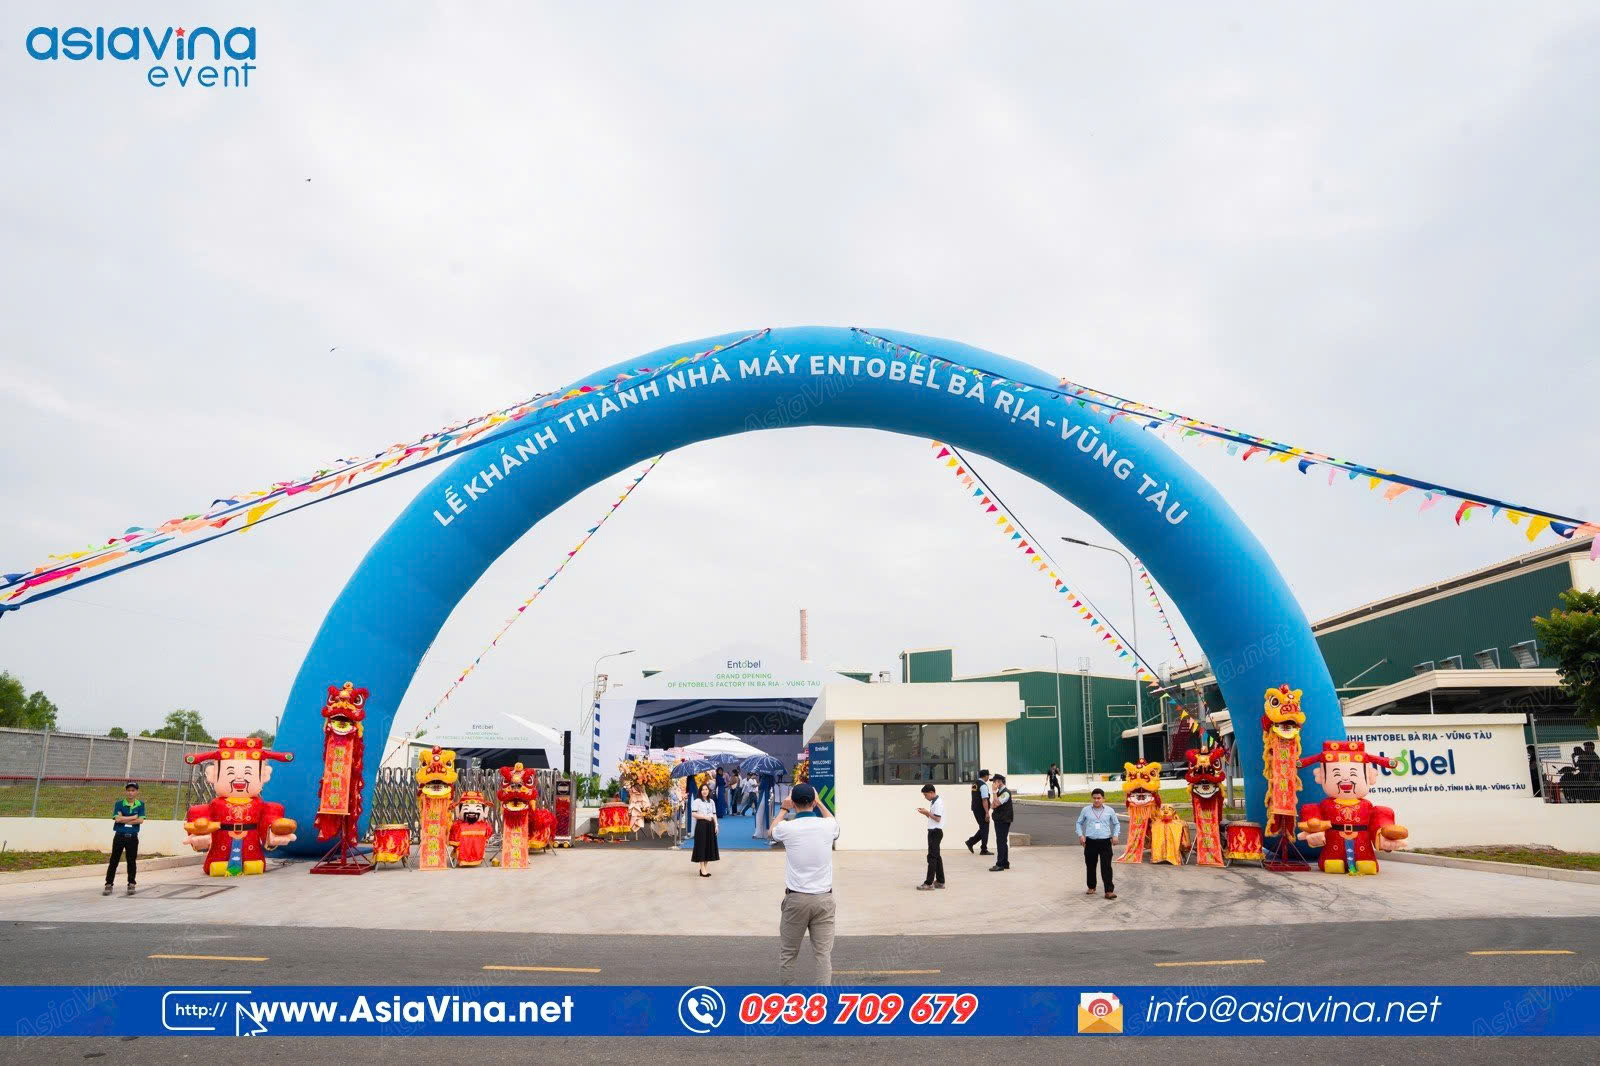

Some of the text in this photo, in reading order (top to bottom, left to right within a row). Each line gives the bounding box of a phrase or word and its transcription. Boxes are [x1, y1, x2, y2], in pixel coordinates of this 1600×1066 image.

[433, 485, 467, 526] LỄ
[463, 425, 558, 501] KHÁNH
[558, 380, 660, 434] THÀNH
[666, 358, 731, 392] NHÀ
[738, 350, 801, 380] MÁY
[810, 354, 941, 390] ENTOBEL
[1136, 473, 1189, 526] TÀU
[1366, 733, 1406, 742] ENTOBEL
[1408, 731, 1420, 741] BÀ
[1422, 733, 1438, 742] RỊA
[1446, 730, 1471, 740] VŨNG
[1474, 730, 1492, 739] TÀU
[1465, 783, 1474, 791] BÀ
[1512, 782, 1526, 790] TÀU
